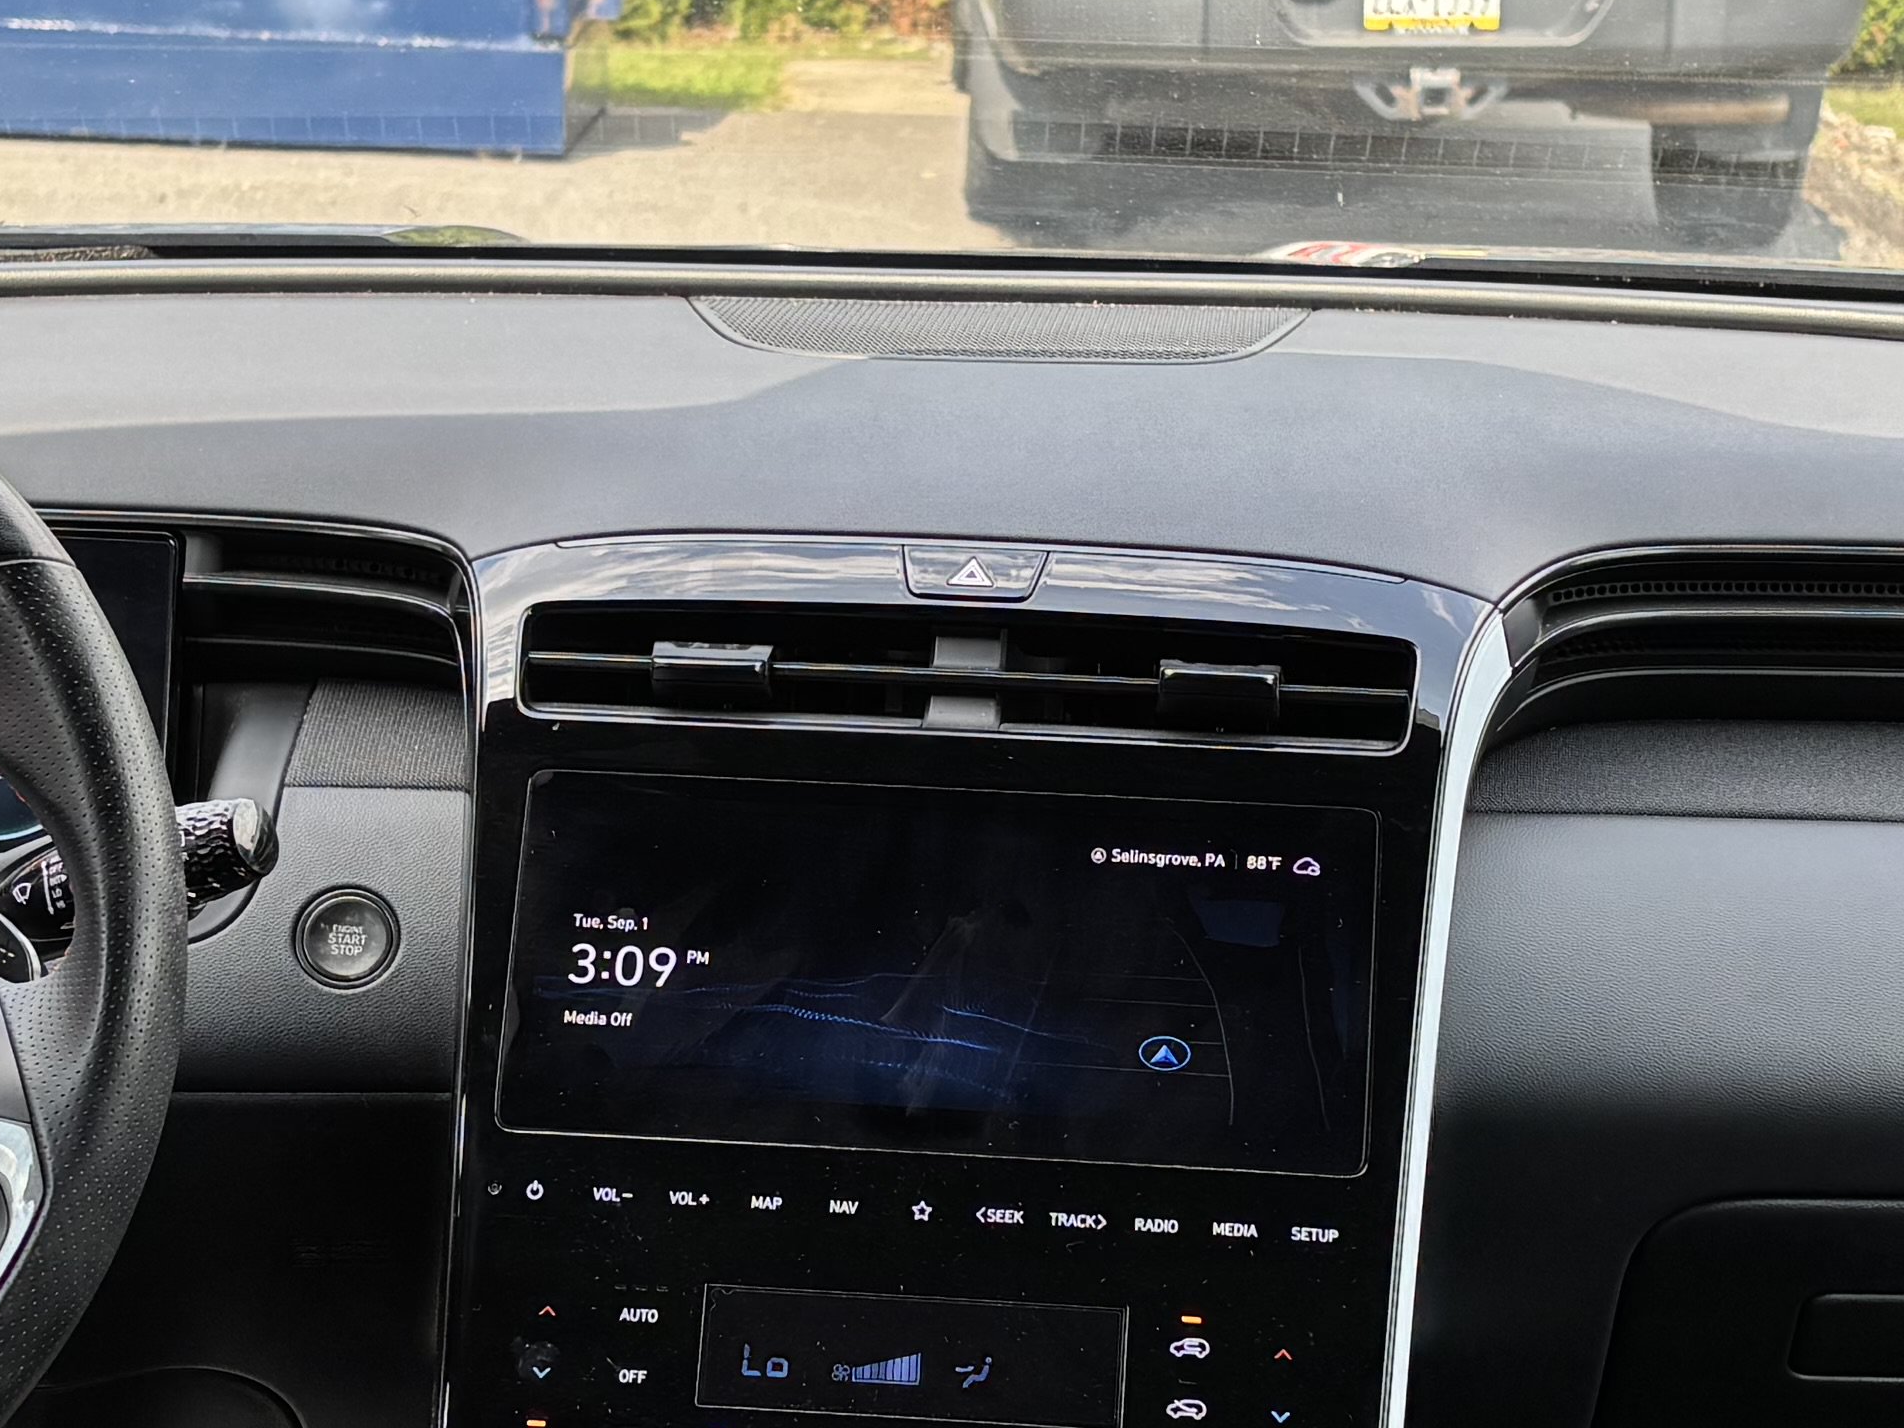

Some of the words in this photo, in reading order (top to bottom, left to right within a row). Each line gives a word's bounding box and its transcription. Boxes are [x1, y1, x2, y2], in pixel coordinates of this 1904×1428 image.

[1111, 847, 1202, 871] Selinsgrove,
[1204, 852, 1226, 869] PA
[573, 913, 604, 930] Tue,
[607, 915, 638, 933] Sep.
[641, 916, 649, 931] 1
[327, 933, 368, 946] START
[330, 944, 364, 957] STOP
[567, 942, 678, 988] 3:09
[686, 949, 710, 965] PM
[563, 1009, 607, 1026] Media
[610, 1011, 634, 1027] Off
[750, 1196, 783, 1211] MAP
[829, 1200, 859, 1215] NAV
[1134, 1217, 1179, 1234] RADIO
[1212, 1222, 1258, 1239] MEDIA
[1291, 1226, 1339, 1244] SETUP
[619, 1308, 659, 1324] AUTO
[618, 1369, 648, 1384] OFF
